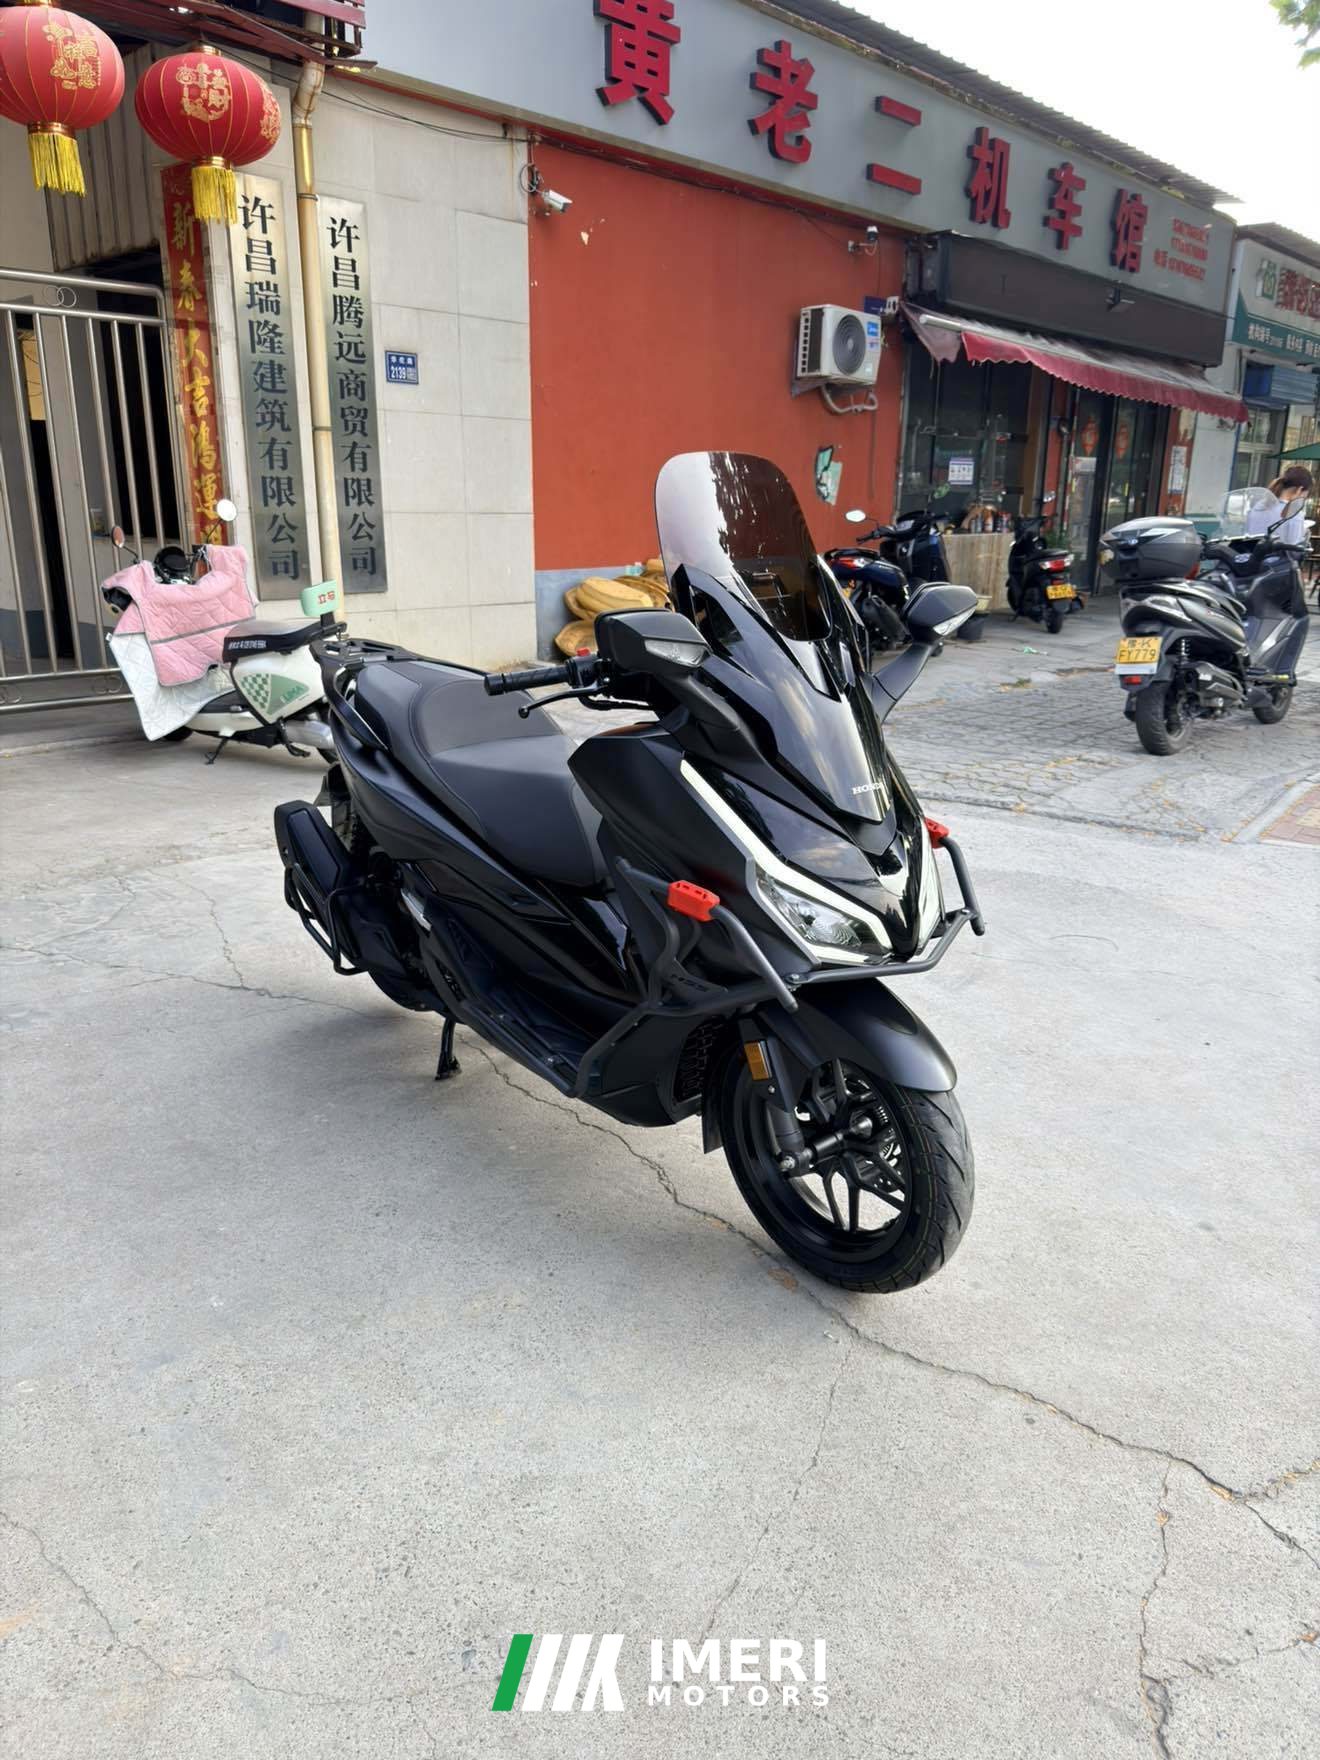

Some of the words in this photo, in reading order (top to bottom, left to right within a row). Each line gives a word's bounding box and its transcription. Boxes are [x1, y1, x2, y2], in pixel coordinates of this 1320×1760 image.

[593, 0, 1148, 273] 黄老二机车馆
[238, 194, 299, 580] 许昌瑞隆建筑有限公司
[327, 216, 377, 576] 许昌腾远商贸有限公司
